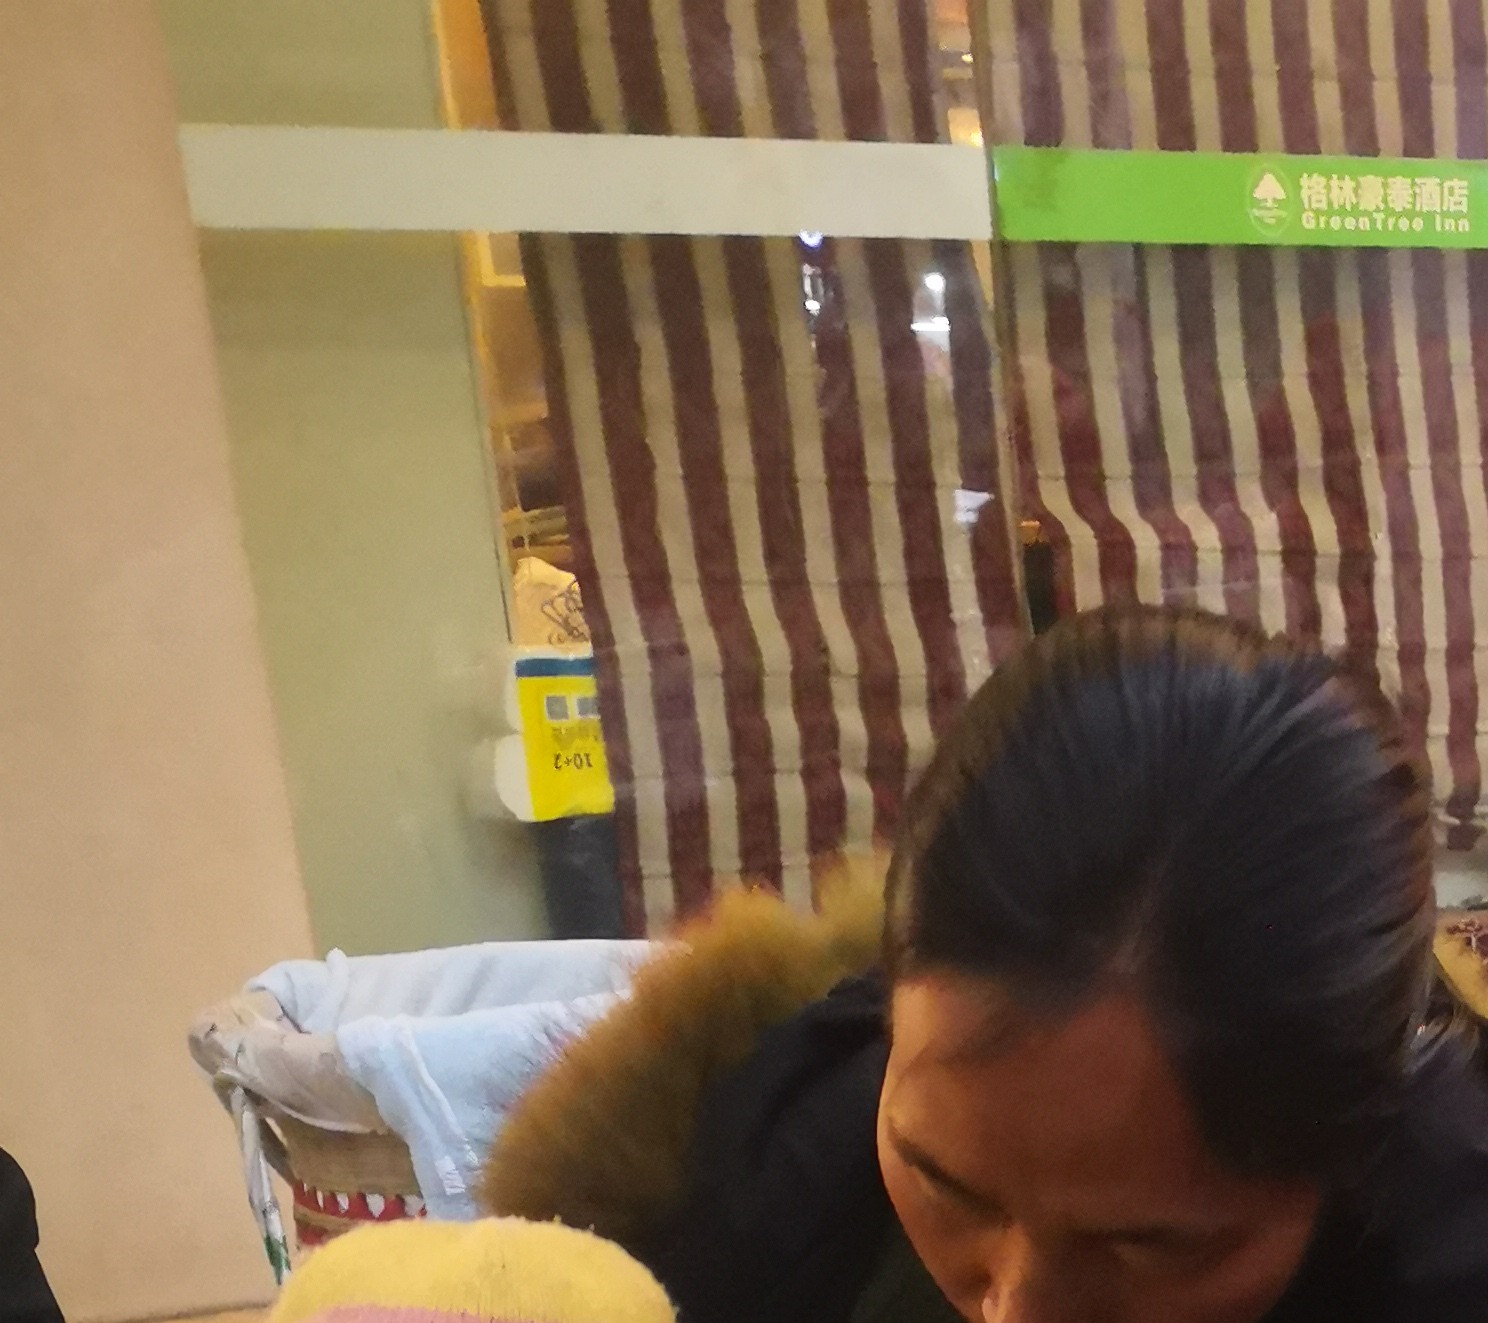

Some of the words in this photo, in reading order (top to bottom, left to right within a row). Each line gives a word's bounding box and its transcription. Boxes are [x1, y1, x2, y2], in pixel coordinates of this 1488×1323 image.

[1299, 172, 1469, 213] 格林豪泰酒店
[1301, 210, 1424, 231] GreenTree
[1434, 213, 1471, 233] Inn
